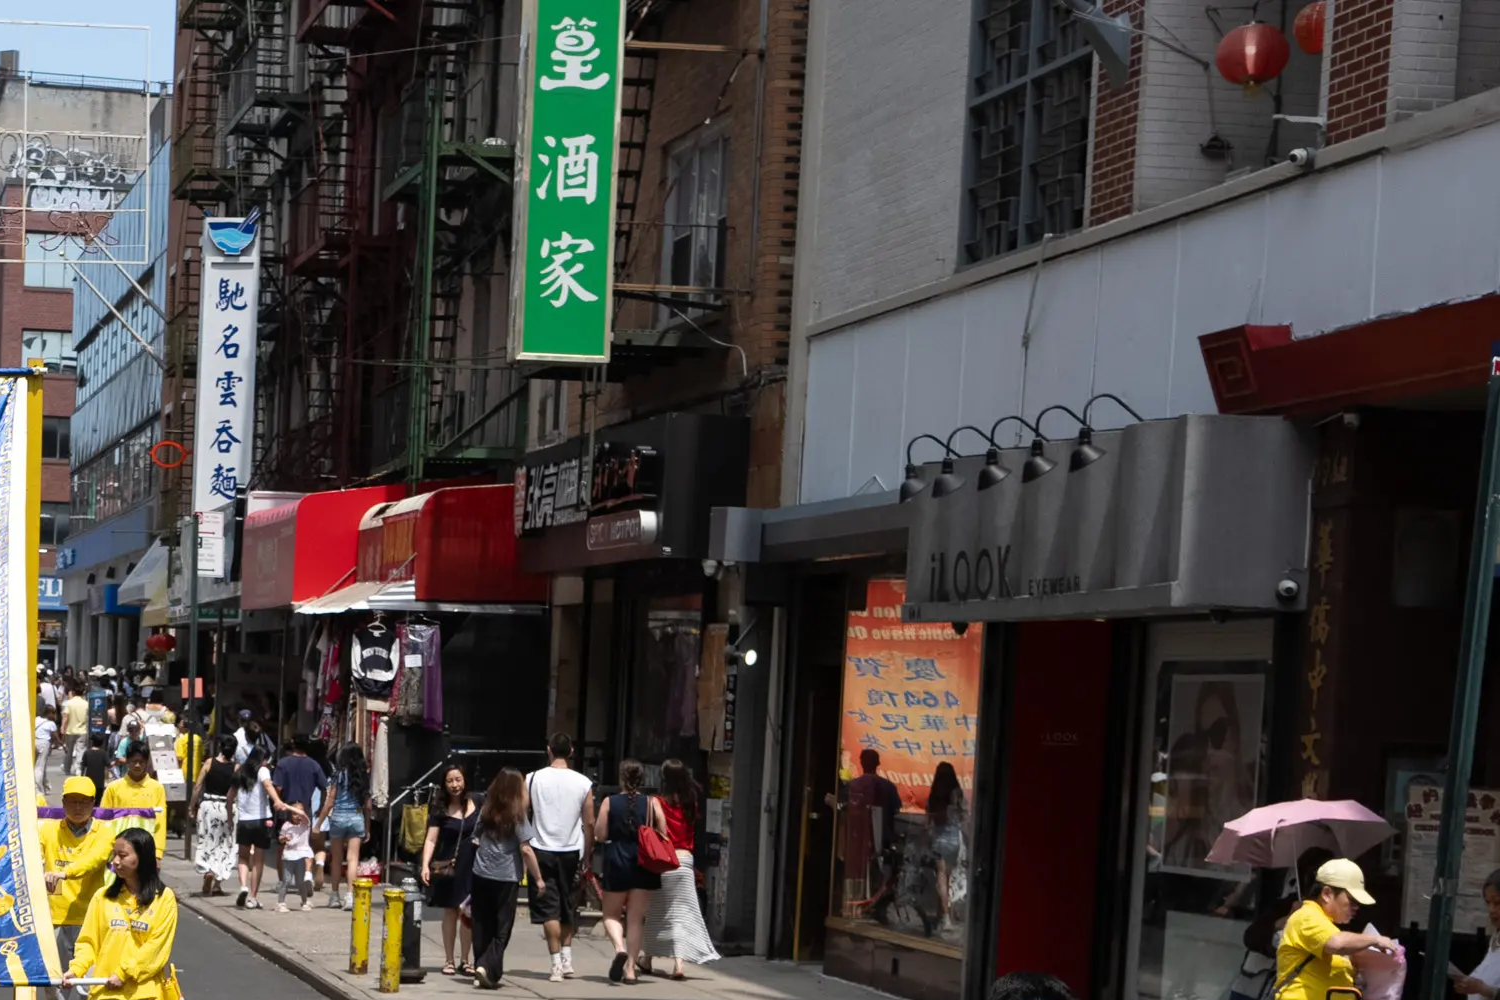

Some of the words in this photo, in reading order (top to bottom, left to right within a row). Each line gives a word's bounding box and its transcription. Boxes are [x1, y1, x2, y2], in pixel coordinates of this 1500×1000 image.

[209, 277, 248, 501] 馳名雲吞麵
[1027, 576, 1081, 597] EYEWEAR
